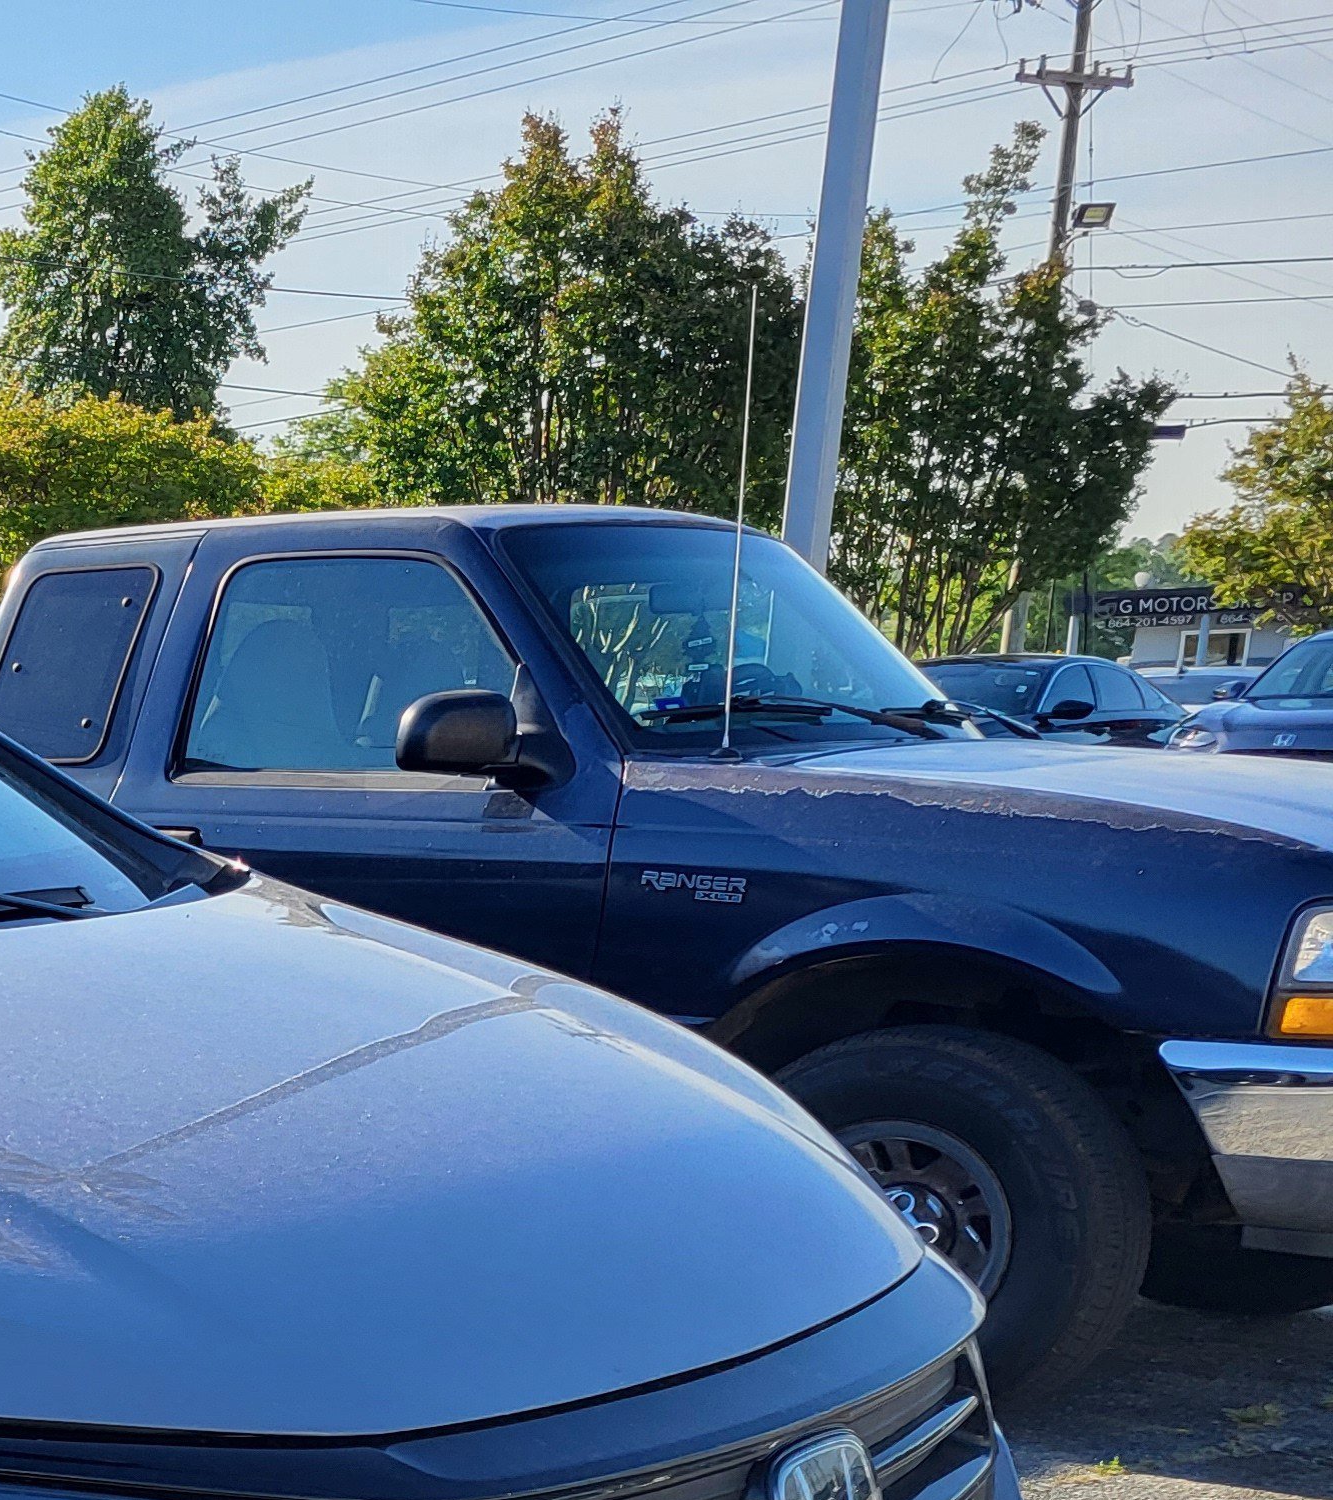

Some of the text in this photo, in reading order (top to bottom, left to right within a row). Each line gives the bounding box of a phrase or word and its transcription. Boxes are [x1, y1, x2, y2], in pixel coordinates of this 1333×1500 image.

[1119, 599, 1133, 613] G
[1139, 596, 1217, 613] MOTORS
[641, 870, 747, 893] RANGER
